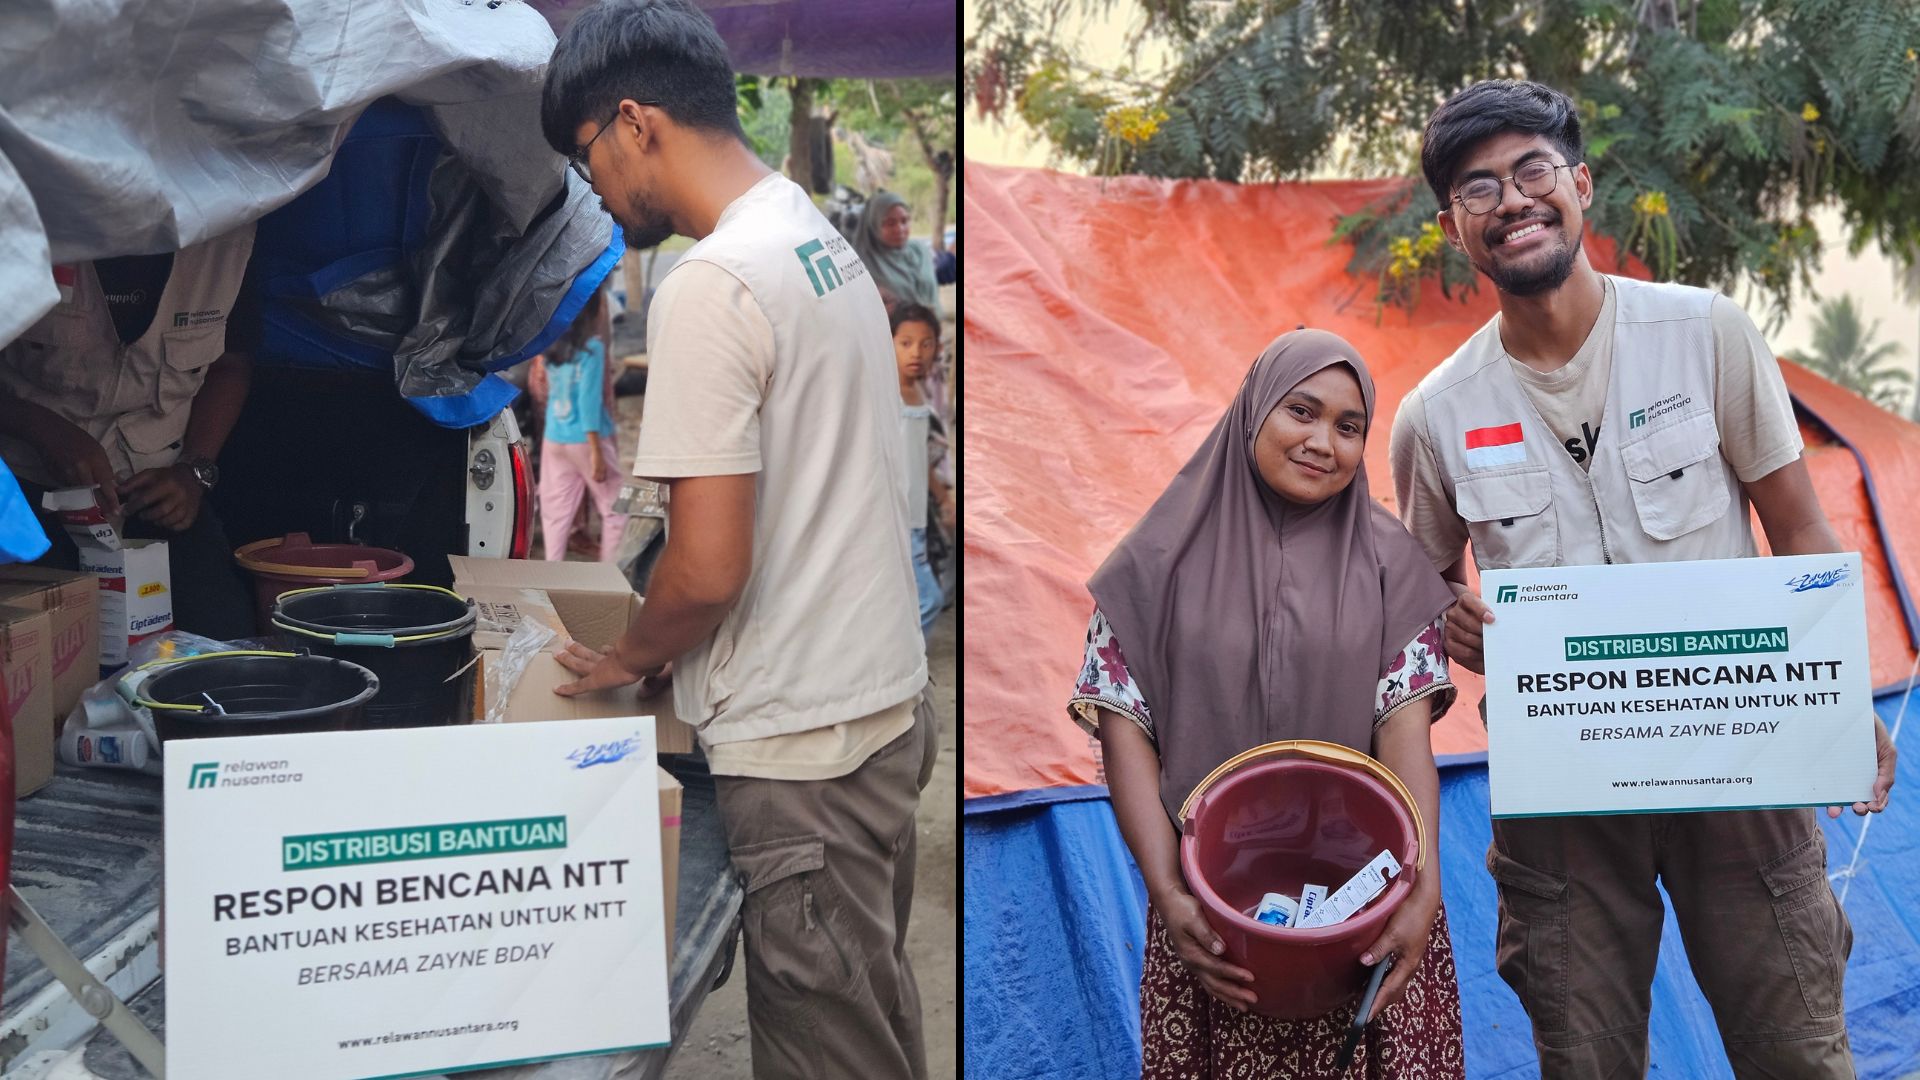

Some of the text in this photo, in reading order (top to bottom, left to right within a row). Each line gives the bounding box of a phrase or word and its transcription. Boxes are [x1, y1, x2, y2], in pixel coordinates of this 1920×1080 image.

[1648, 393, 1682, 413] relawan
[1648, 397, 1691, 422] nusantara
[1520, 593, 1578, 602] nusantara
[1521, 584, 1568, 592] relawan
[130, 613, 171, 631] Ciptadent
[1567, 631, 1786, 656] DISTRIBUSI BANTUAN
[1517, 661, 1842, 693] RESPON BENCANA NTT
[1527, 692, 1840, 717] BANTUAN KESEHATAN UNTUK NTT
[1580, 721, 1780, 741] BERSAMA ZAYNE BDAY
[224, 760, 289, 773] relawan
[221, 773, 303, 787] nusantara
[1611, 776, 1753, 788] www.relawannusantara.org
[285, 822, 565, 865] DISTRIBUSI BANTUAN
[214, 859, 629, 921] RESPON BENCANA NTT
[1303, 891, 1317, 920] Cipta
[226, 900, 627, 956] BANTUAN KESEHATAN UNTUK NTT
[298, 942, 554, 986] BERSAMA ZAYNE BDAY
[338, 1019, 519, 1049] www.relawannusantara.org
